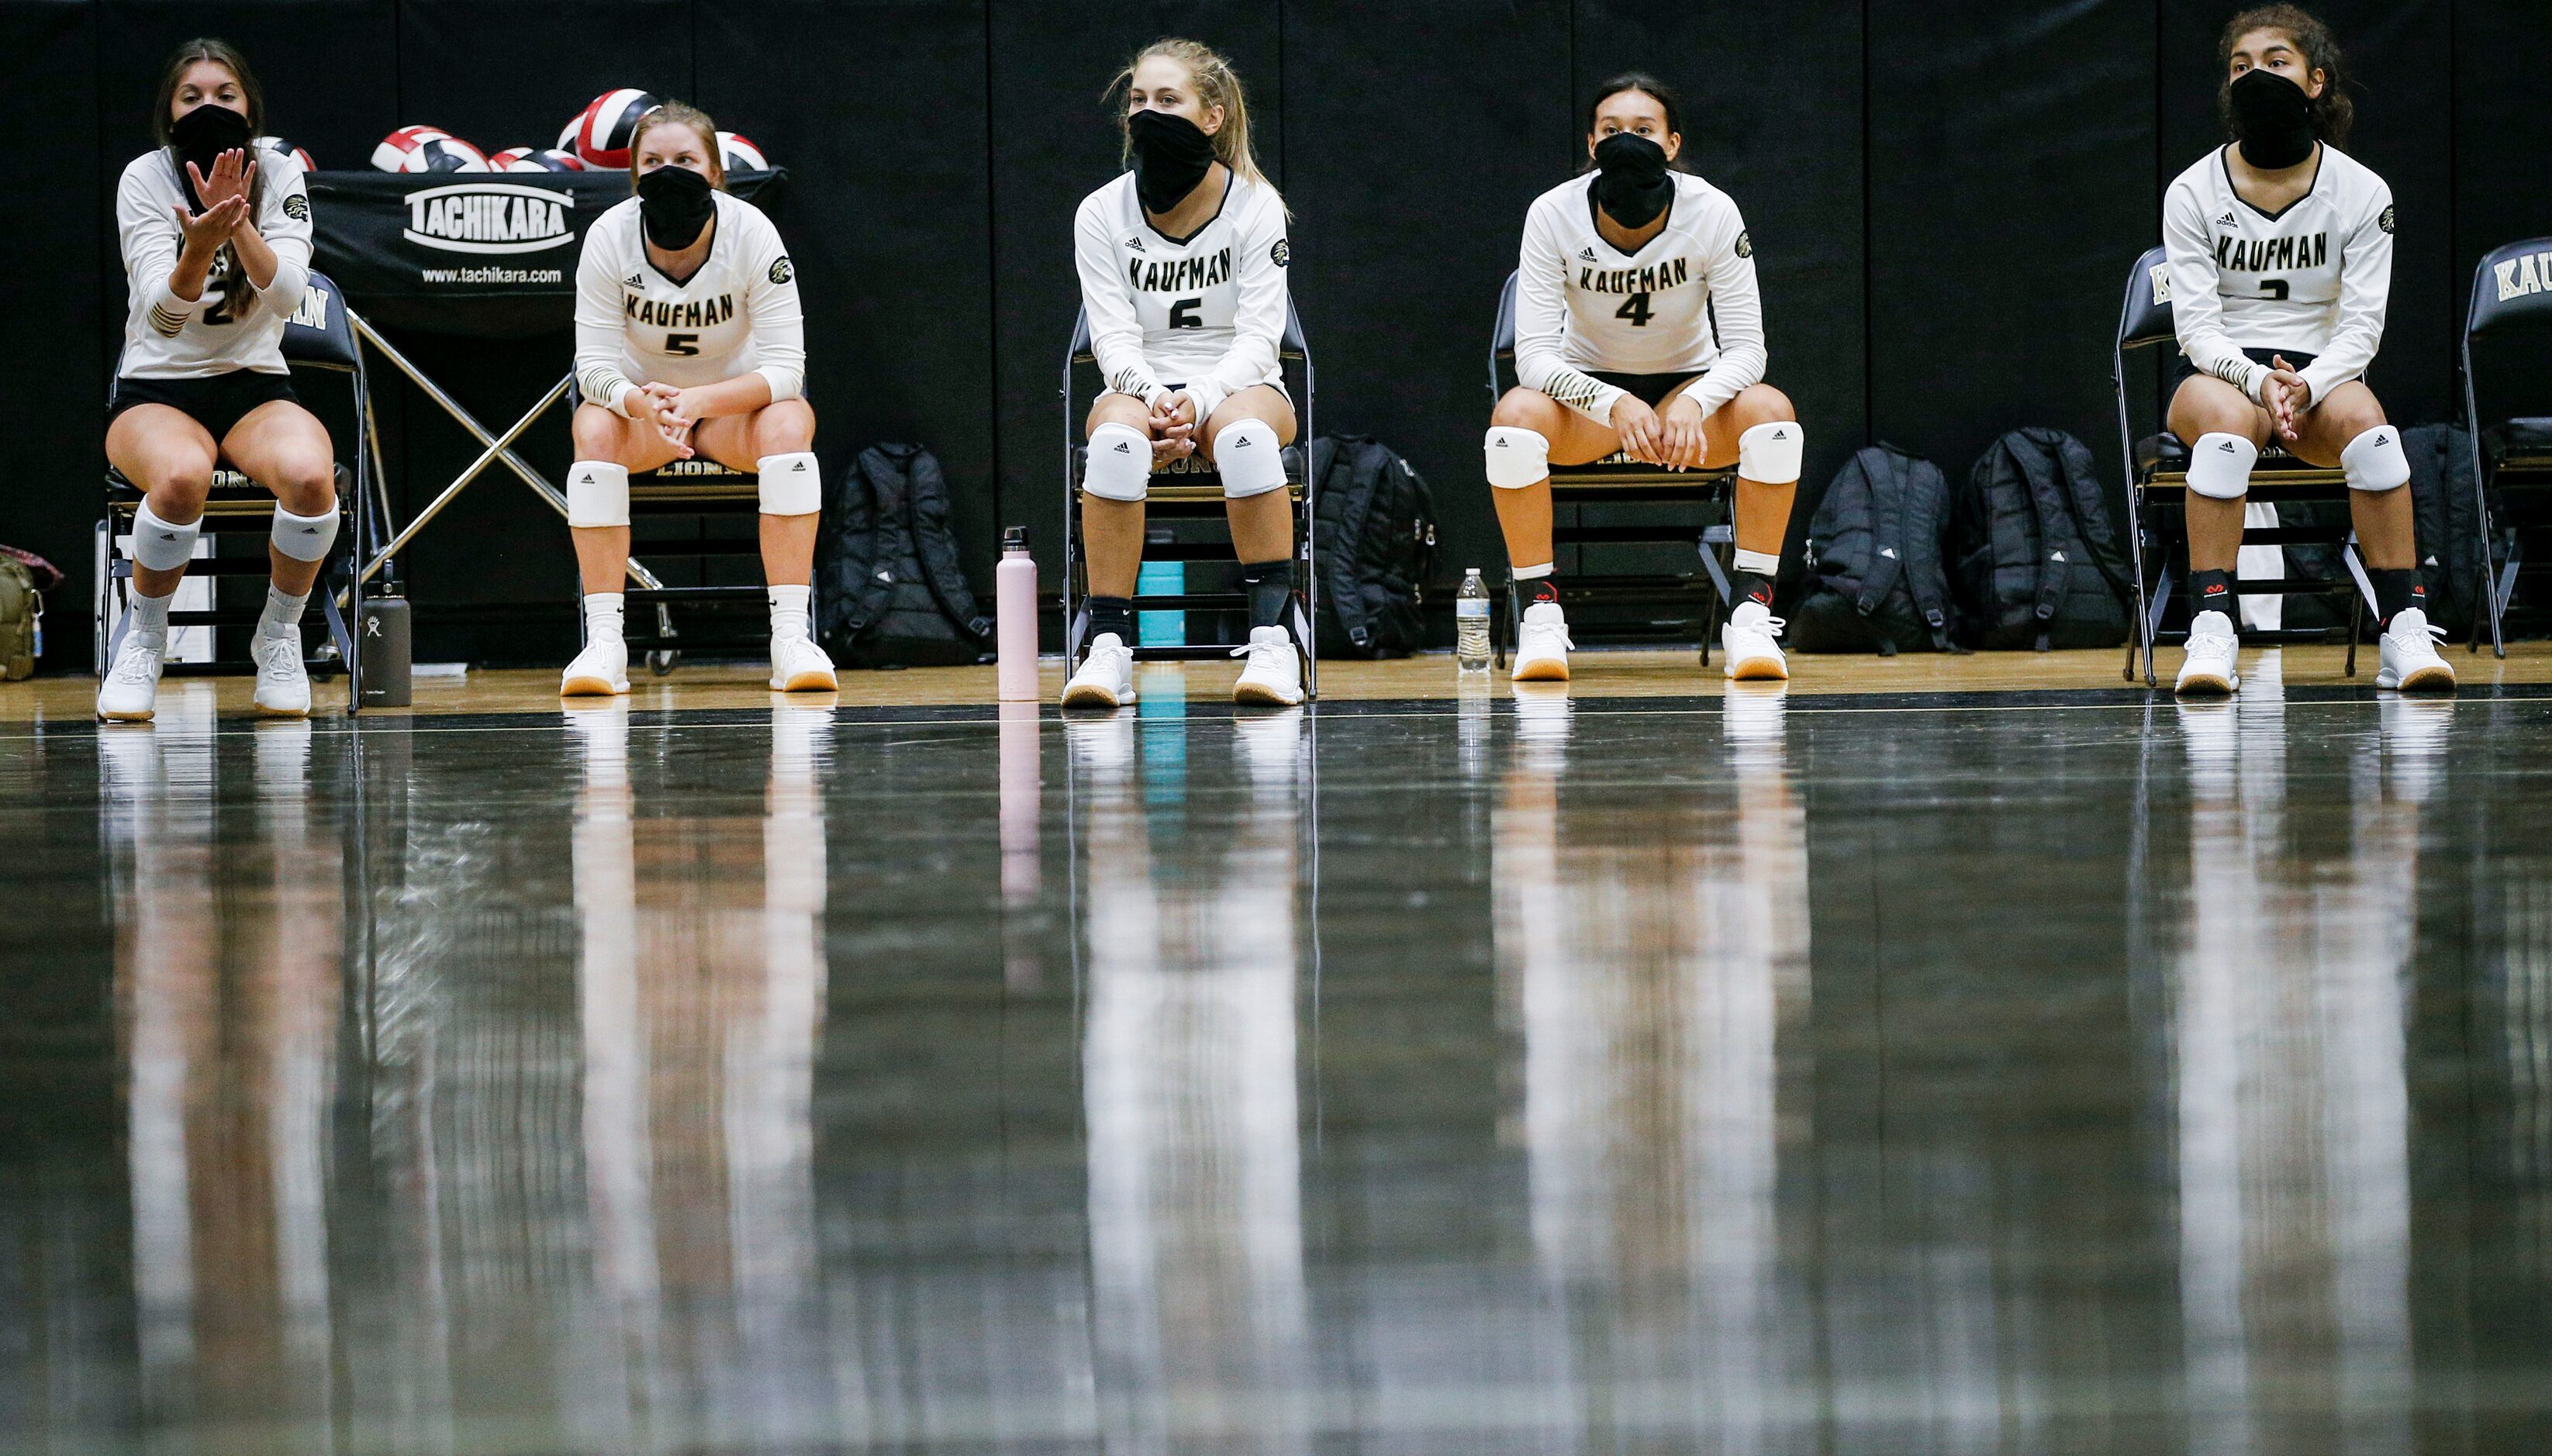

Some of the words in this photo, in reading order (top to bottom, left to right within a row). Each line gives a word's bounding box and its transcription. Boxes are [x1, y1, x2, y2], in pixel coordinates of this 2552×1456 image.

[405, 188, 568, 242] TACHIKARA
[2216, 219, 2239, 229] adidas
[2216, 231, 2327, 271] KAUFMAN
[422, 267, 561, 283] www.tachikara.com
[1129, 247, 1231, 292] KAUFMAN
[1580, 257, 1687, 294] KAUFMAN
[626, 292, 734, 328] KAUFMAN
[1169, 297, 1203, 330] 6
[1614, 292, 1656, 326] 4
[665, 333, 700, 356] 5
